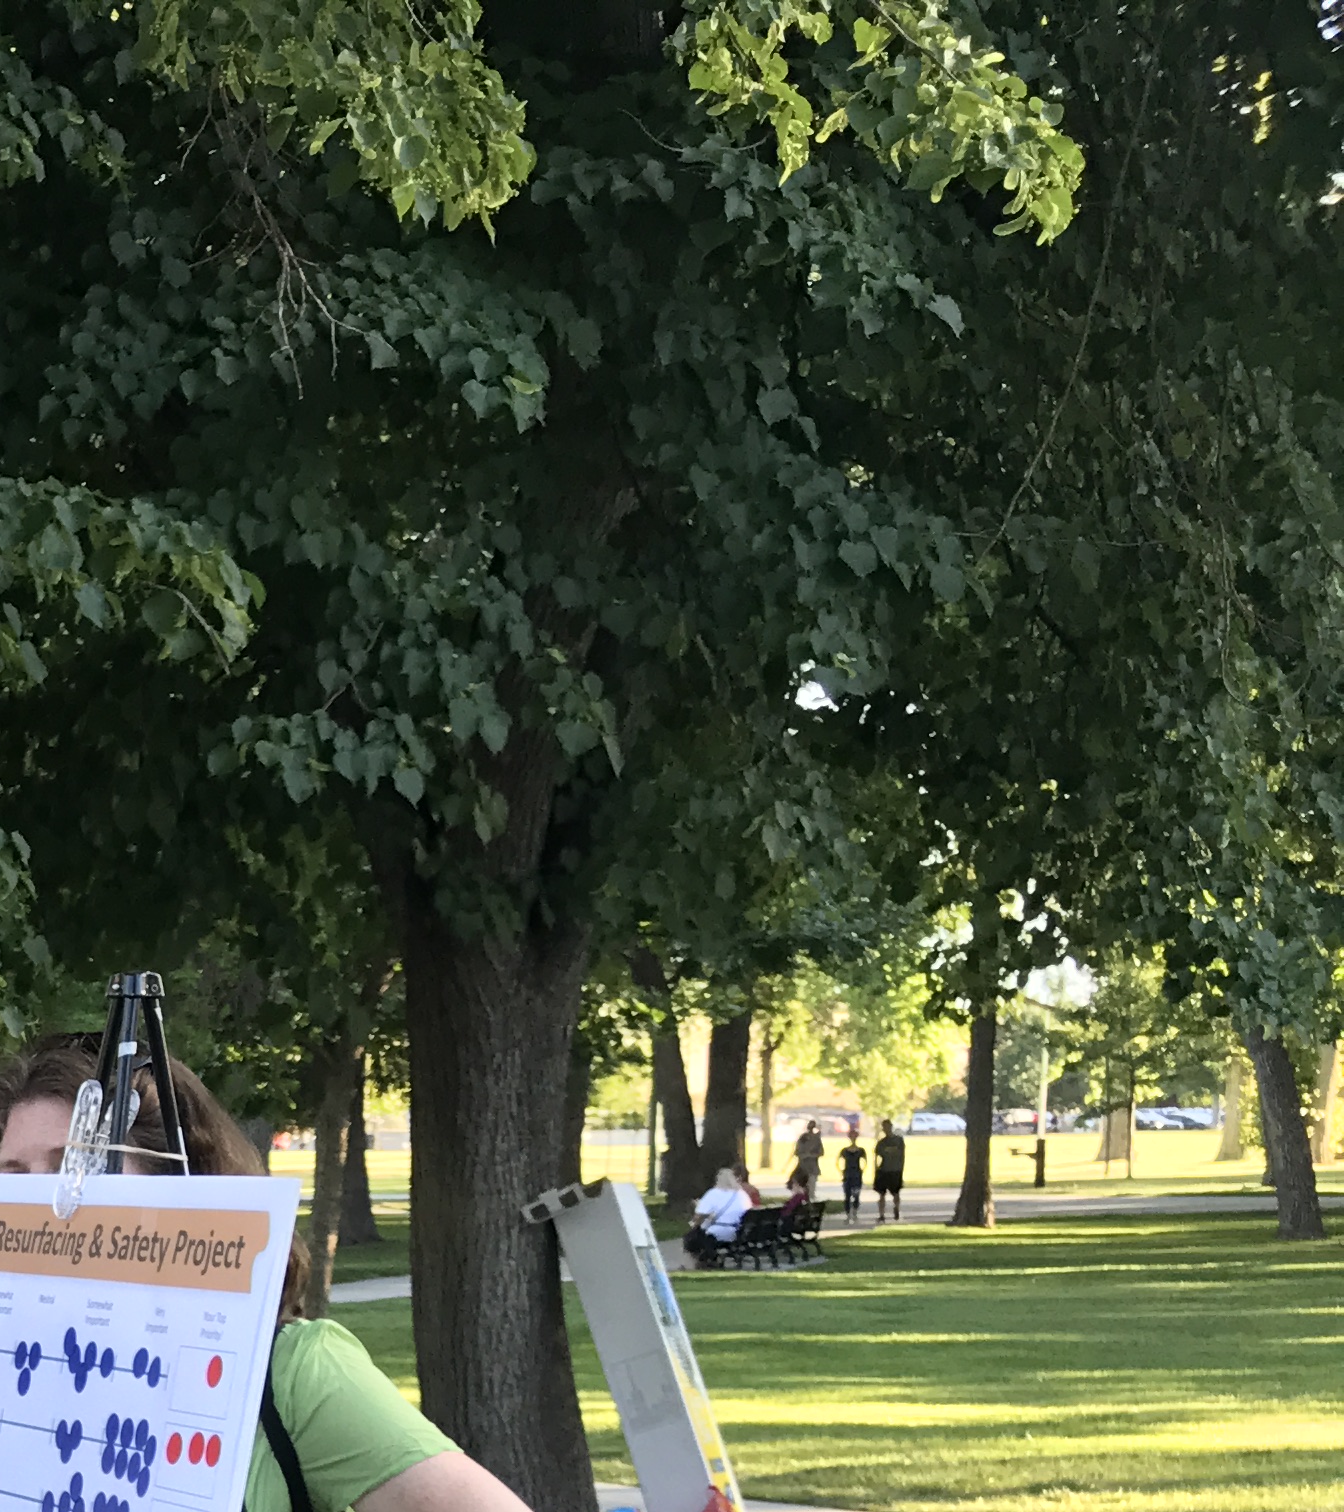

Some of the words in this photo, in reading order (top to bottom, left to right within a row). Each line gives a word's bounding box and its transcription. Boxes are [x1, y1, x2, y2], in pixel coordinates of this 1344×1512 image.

[88, 1224, 104, 1259] &
[107, 1225, 169, 1273] Safety
[173, 1231, 245, 1271] Project
